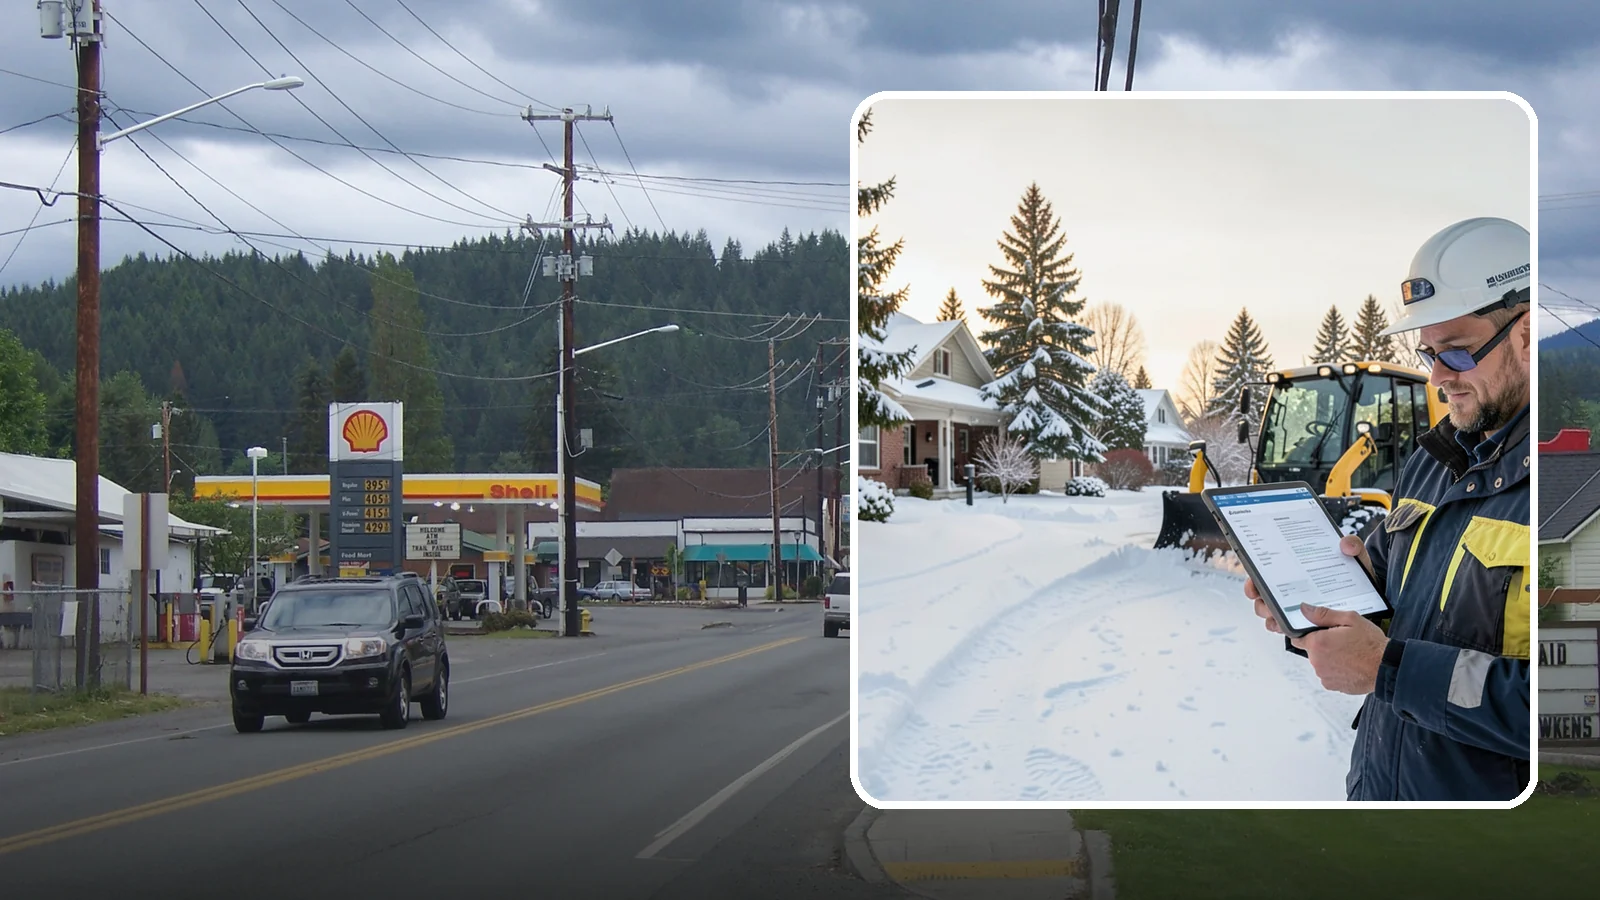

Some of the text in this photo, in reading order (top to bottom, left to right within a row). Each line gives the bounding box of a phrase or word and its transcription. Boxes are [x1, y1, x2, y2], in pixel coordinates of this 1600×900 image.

[366, 480, 383, 490] 395
[490, 484, 547, 499] Shell
[366, 494, 383, 504] 405
[366, 508, 383, 518] 415
[366, 522, 383, 532] 429
